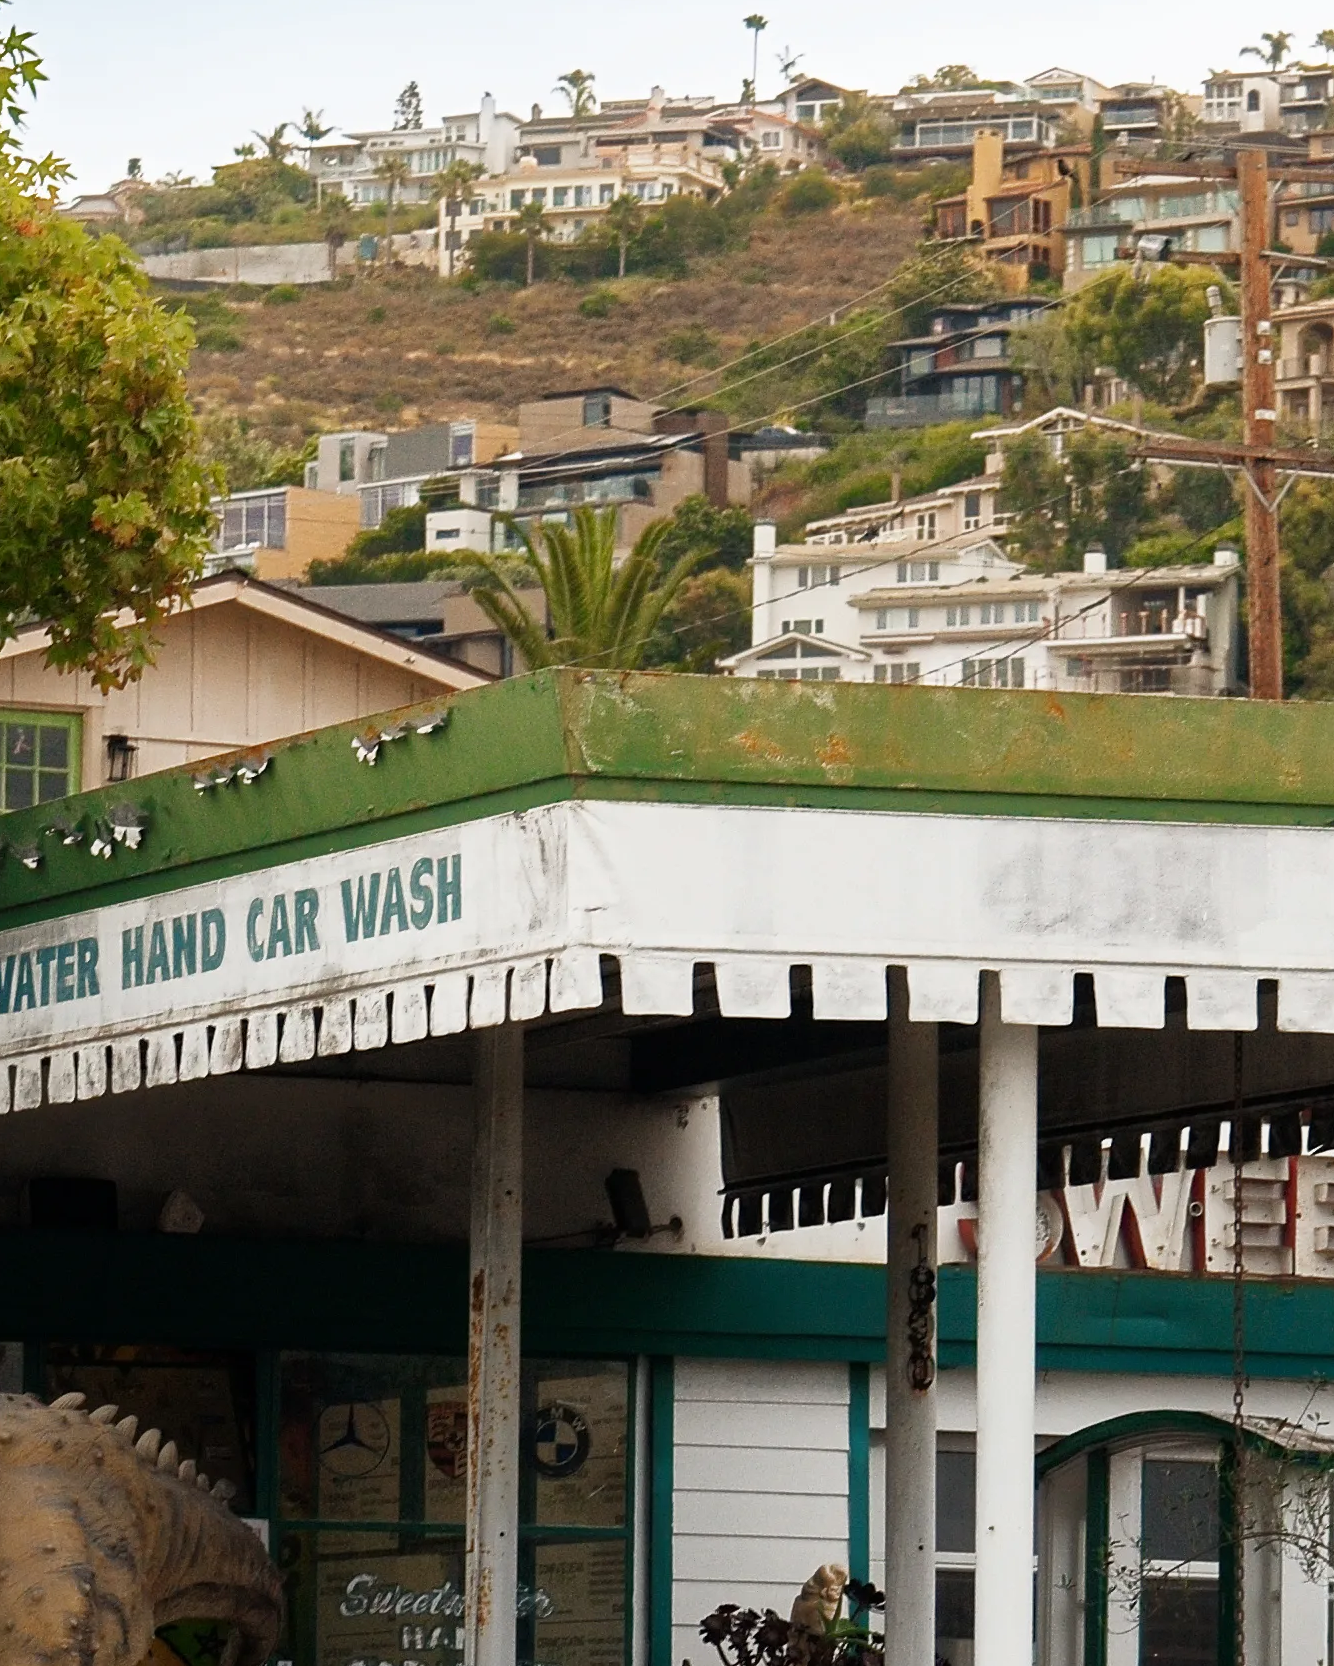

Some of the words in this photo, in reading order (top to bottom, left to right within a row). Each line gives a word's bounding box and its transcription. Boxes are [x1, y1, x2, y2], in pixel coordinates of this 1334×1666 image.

[121, 907, 226, 990] HAND
[246, 887, 320, 963] CAR
[340, 853, 462, 943] WASH
